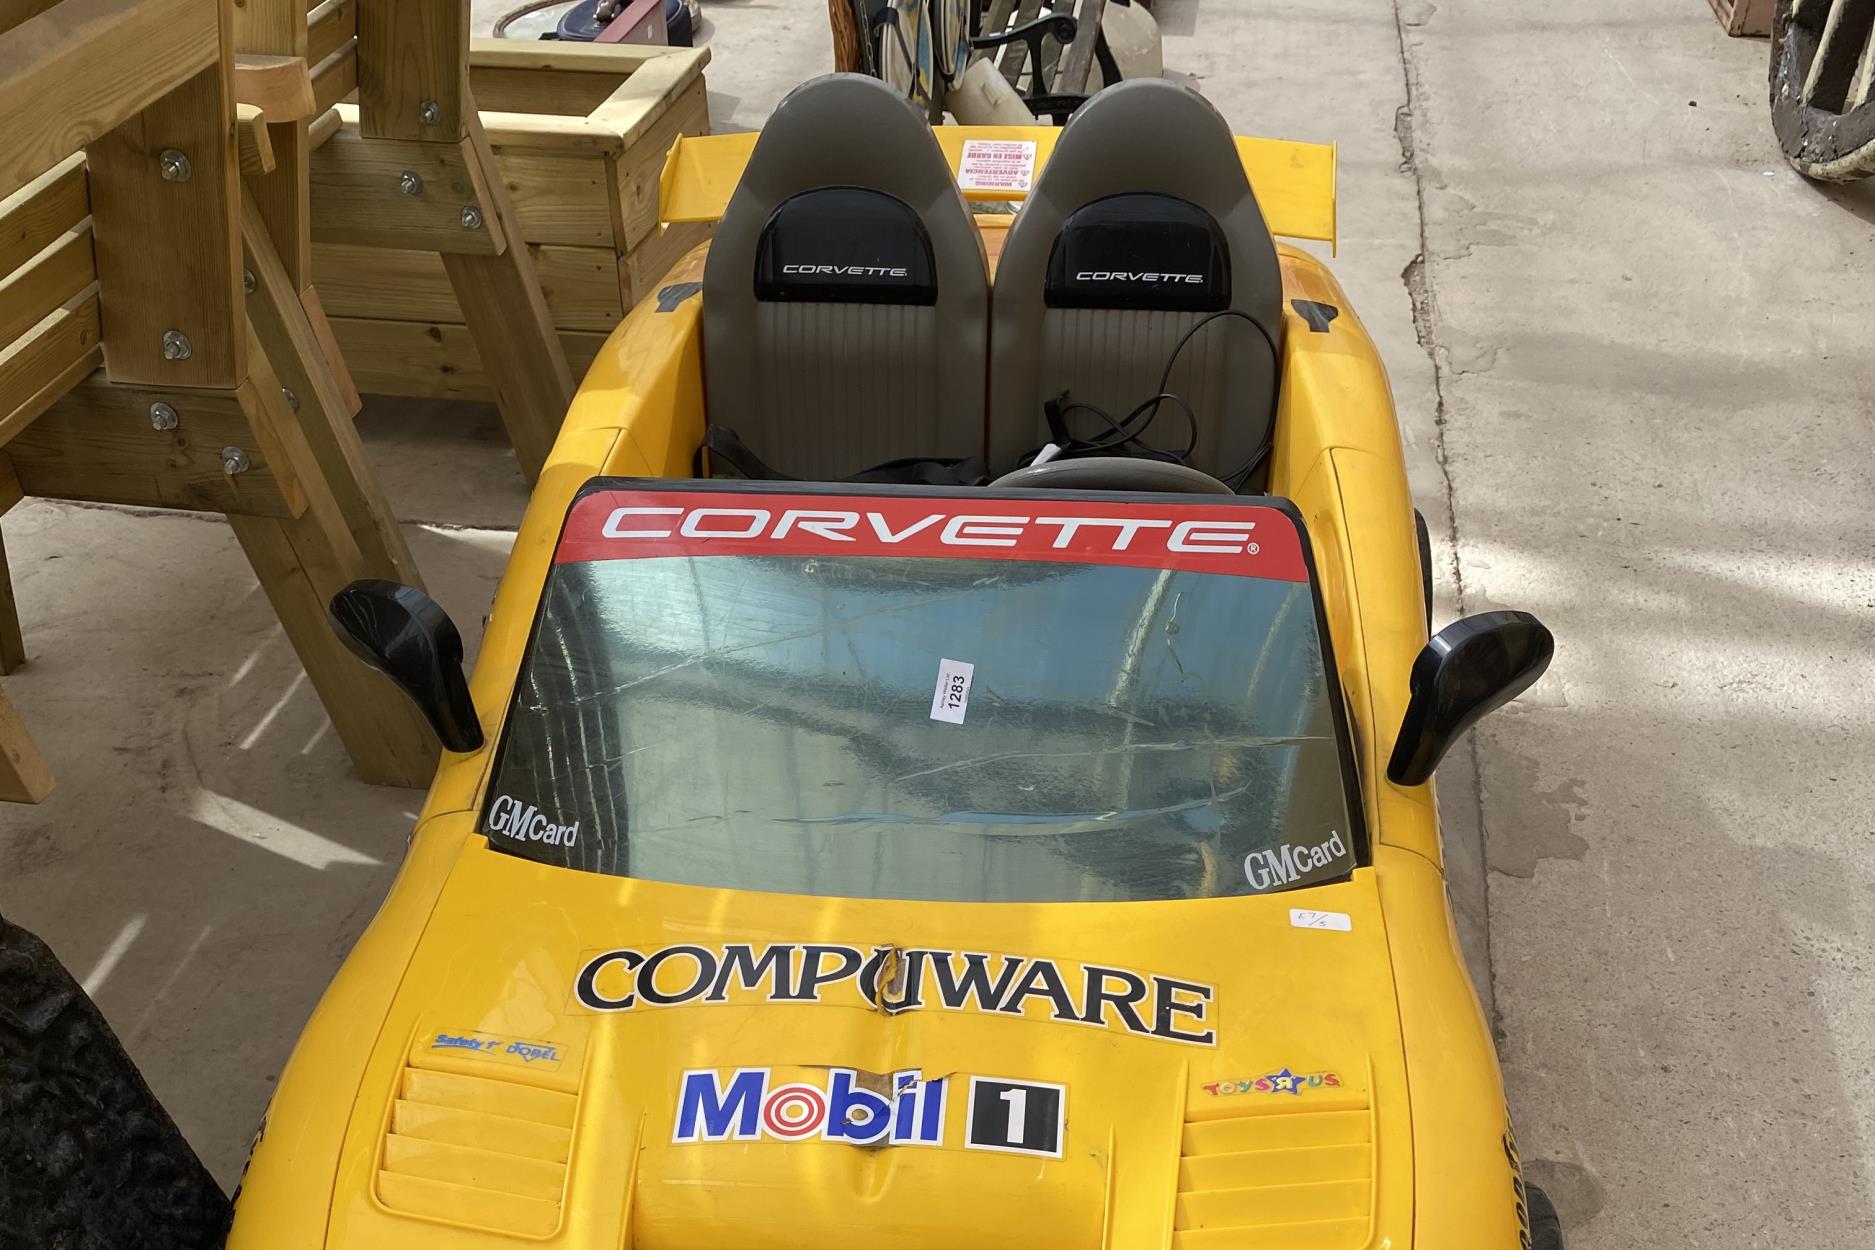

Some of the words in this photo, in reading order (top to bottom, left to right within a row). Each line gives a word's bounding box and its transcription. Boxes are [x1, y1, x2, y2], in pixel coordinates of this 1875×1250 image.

[783, 264, 908, 277] CORVETTE
[1076, 272, 1203, 283] CORVETTE
[948, 675, 965, 709] 1283
[576, 945, 1216, 1047] COMPUWARE
[1203, 1077, 1271, 1096] TOYS
[1306, 1072, 1341, 1088] US
[674, 1068, 948, 1146] Mobil
[999, 1088, 1027, 1144] 1
